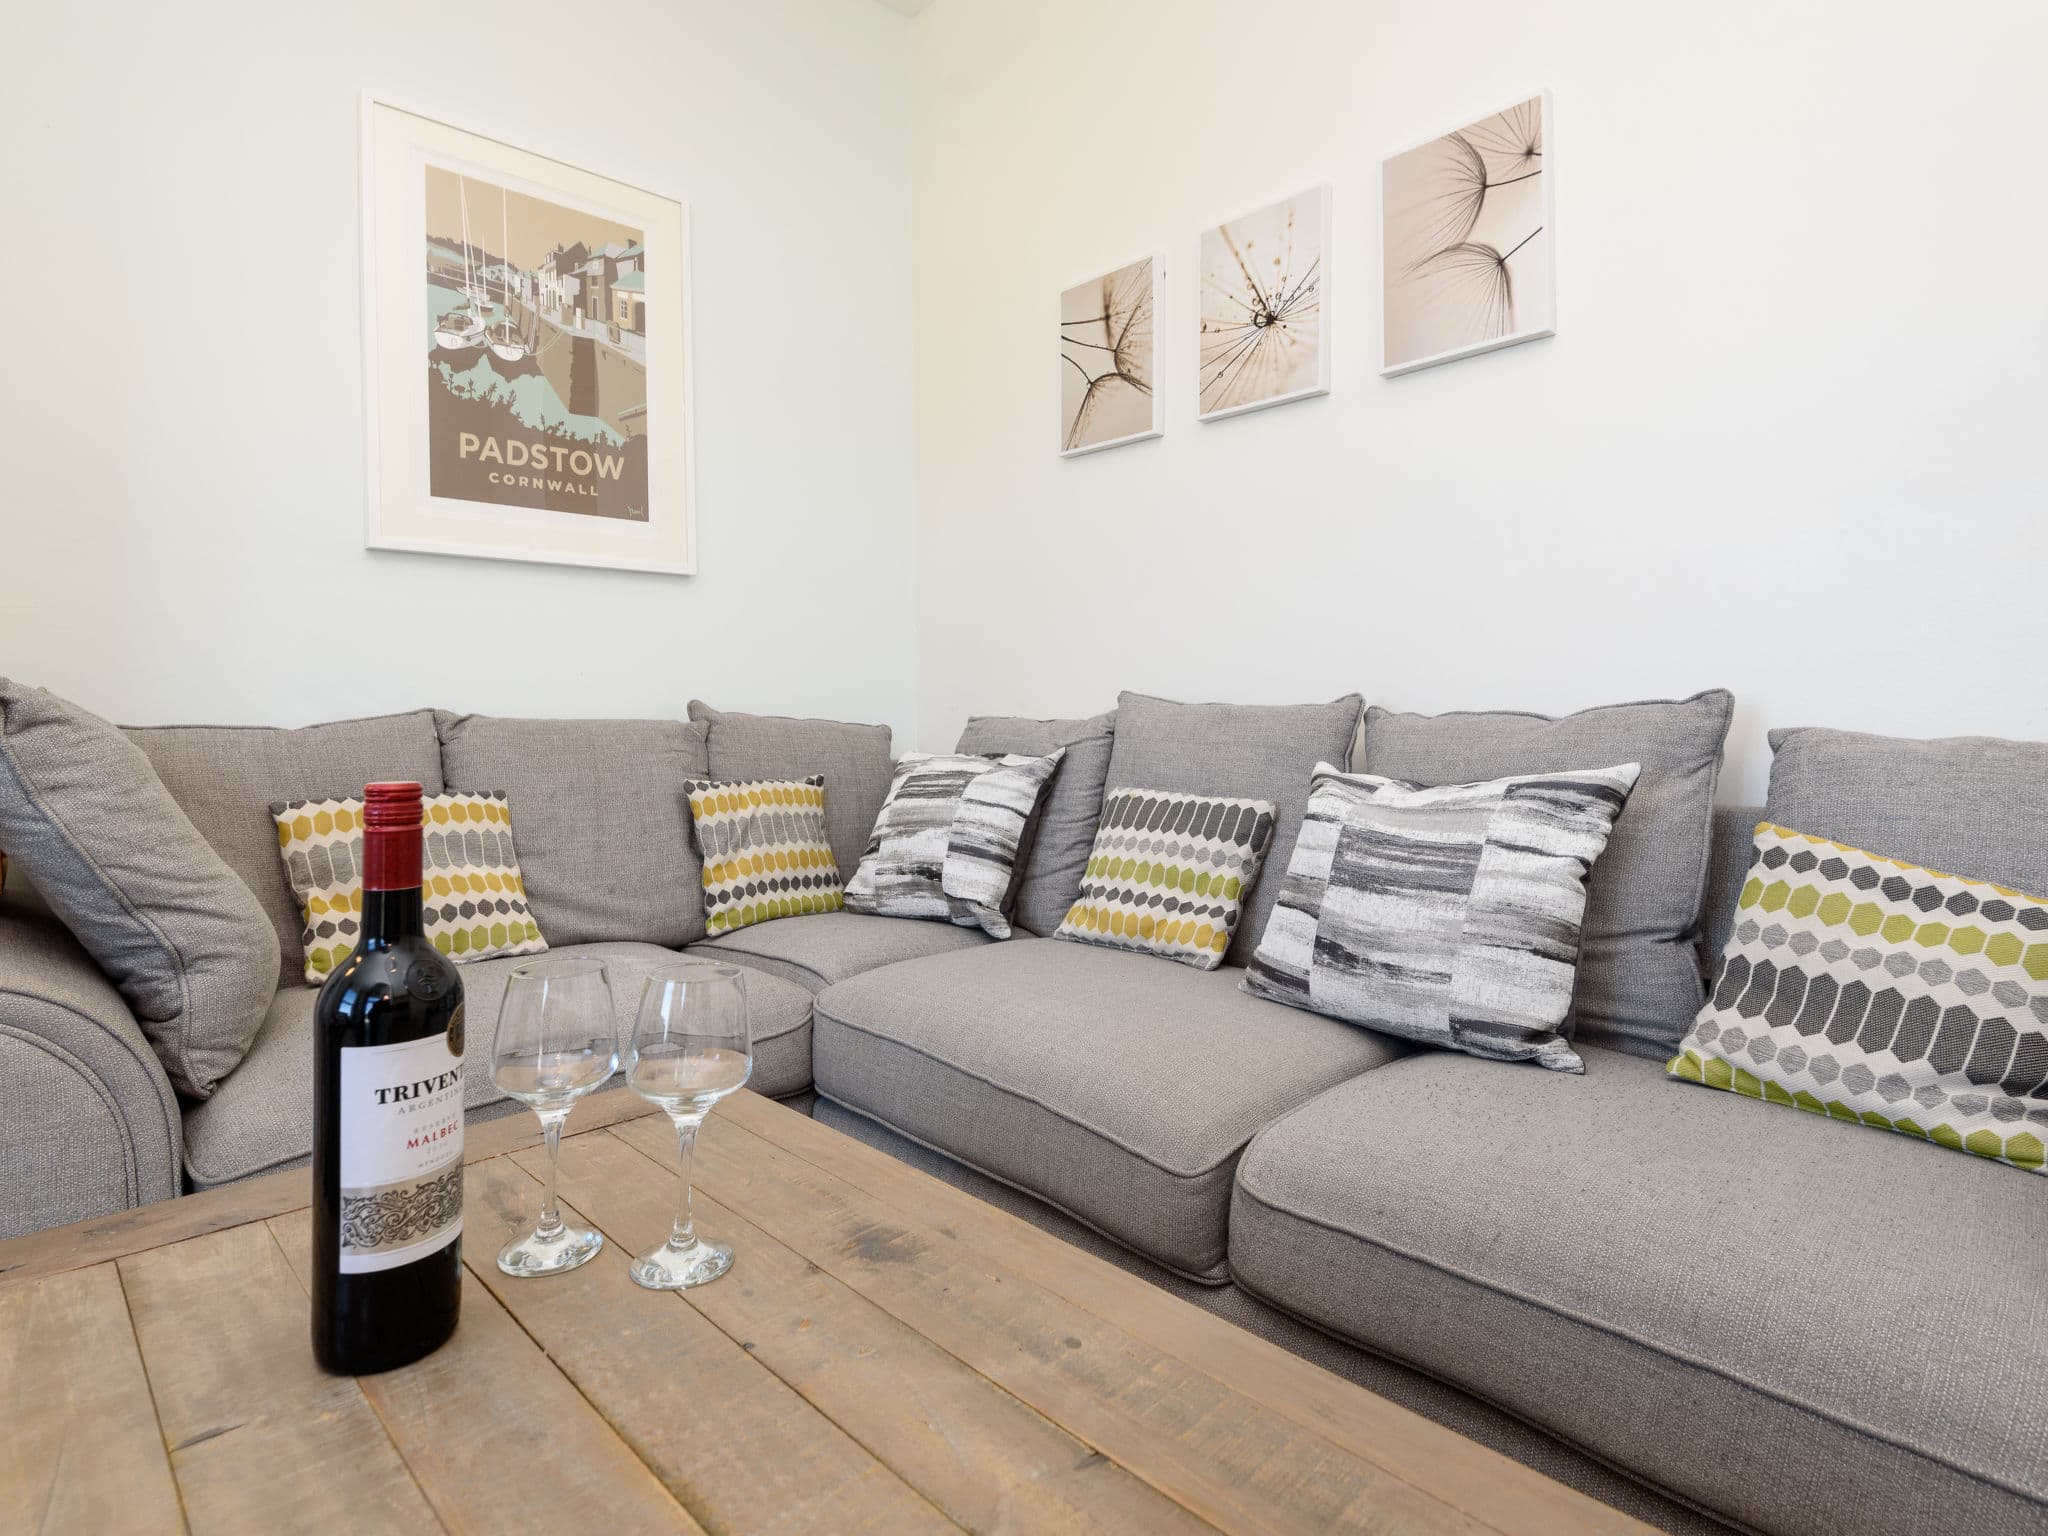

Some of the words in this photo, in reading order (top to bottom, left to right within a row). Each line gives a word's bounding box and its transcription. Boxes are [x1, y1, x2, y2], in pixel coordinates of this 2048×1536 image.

[459, 432, 624, 480] PADSTOW
[489, 472, 598, 496] CORNWALL
[398, 1086, 463, 1115] ARGENTIN
[407, 1120, 459, 1149] MALBEC
